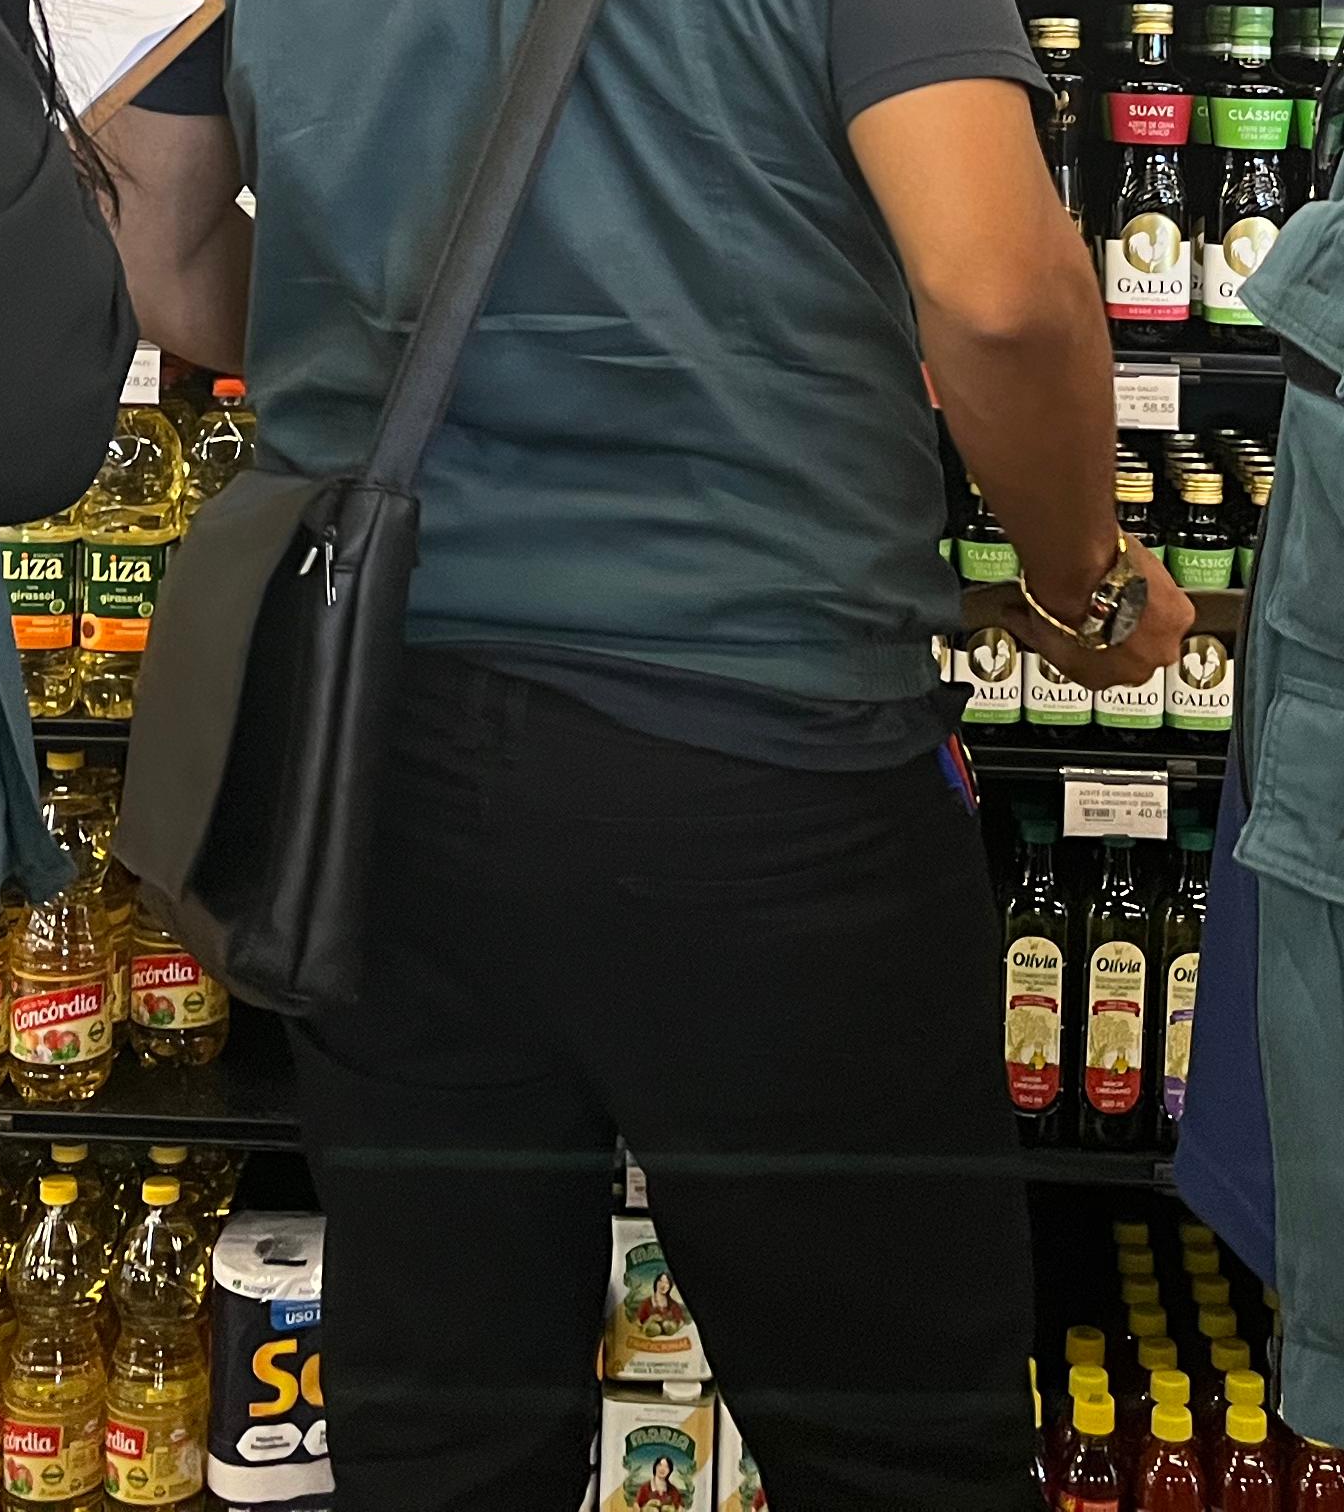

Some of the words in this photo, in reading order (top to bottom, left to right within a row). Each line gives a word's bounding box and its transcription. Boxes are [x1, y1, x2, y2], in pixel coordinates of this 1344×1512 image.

[1129, 104, 1175, 117] SUAVE
[1228, 106, 1289, 122] CLÁSSICO
[1117, 276, 1183, 296] GALLO
[2, 550, 63, 581] Liza
[91, 552, 152, 583] Liza
[10, 591, 55, 605] girassol
[100, 593, 143, 606] girassol
[974, 685, 1019, 700] ALLO
[1031, 685, 1089, 702] GALLO
[1101, 688, 1159, 706] GALLO
[1171, 690, 1230, 707] GALLO
[13, 994, 98, 1032] Concórdia
[286, 1311, 313, 1325] USO
